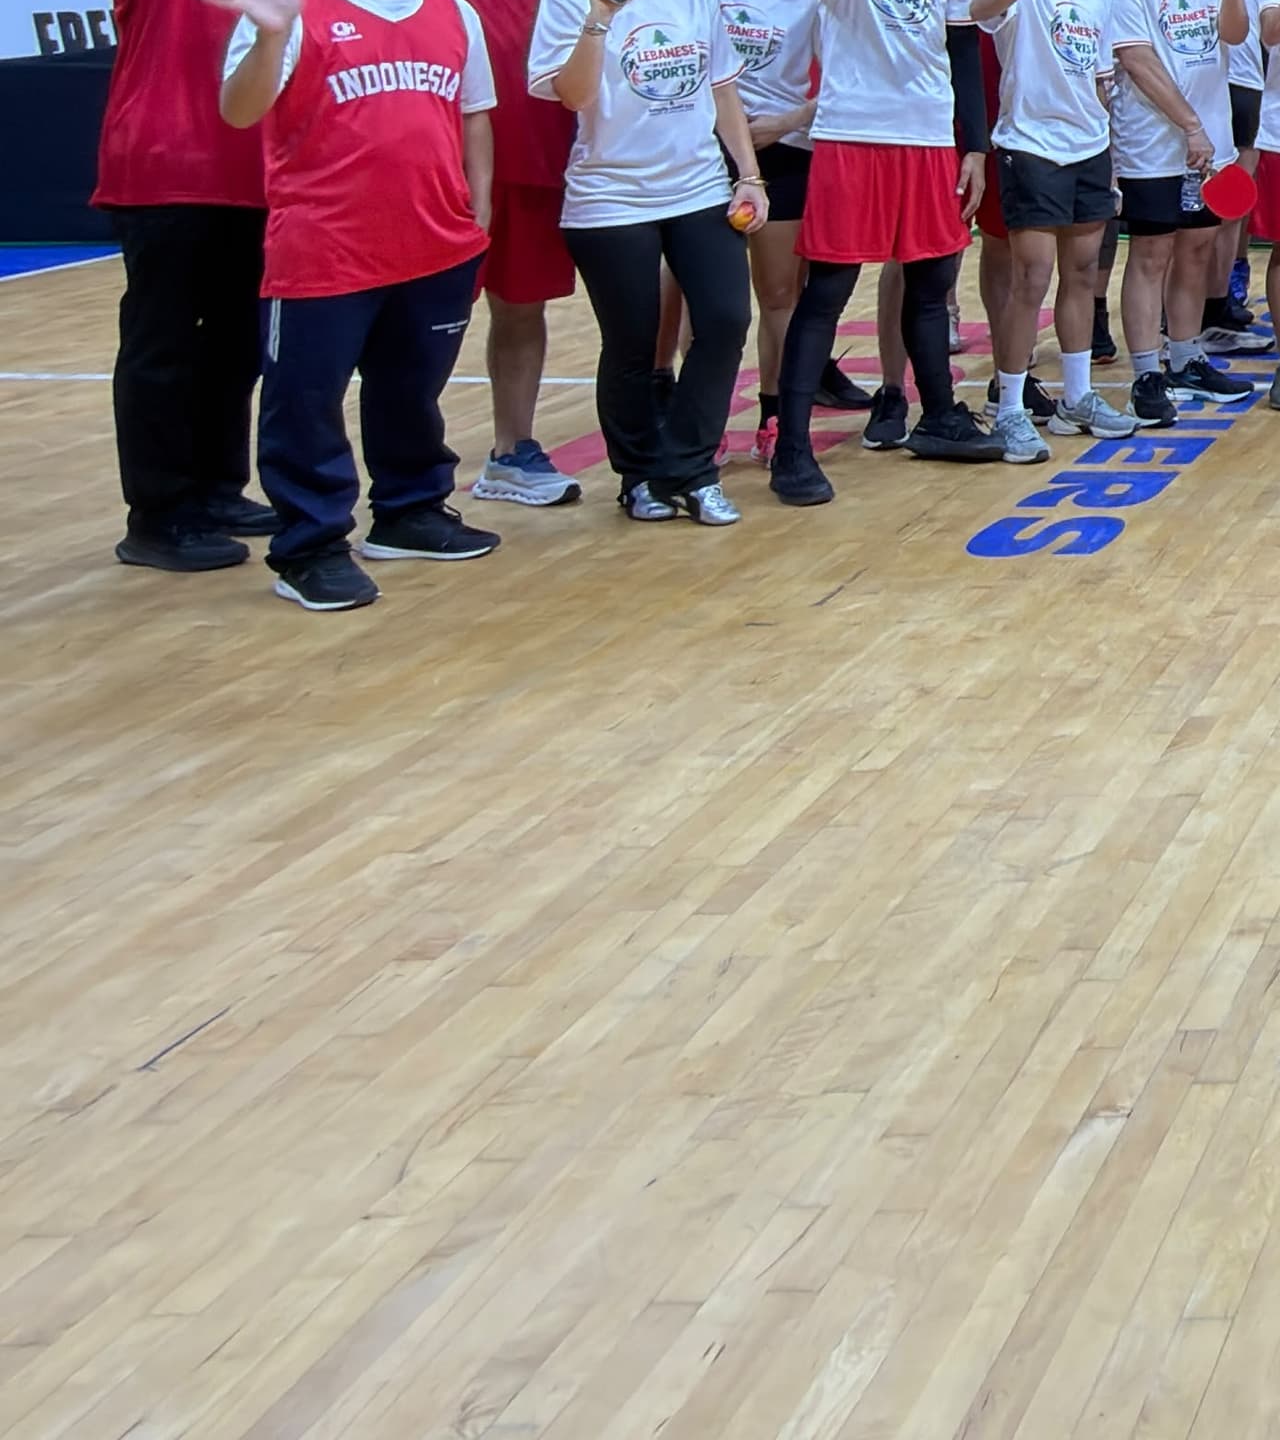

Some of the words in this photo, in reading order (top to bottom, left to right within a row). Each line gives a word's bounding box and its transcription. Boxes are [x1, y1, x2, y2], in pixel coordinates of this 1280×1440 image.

[726, 24, 769, 40] BANESE
[637, 44, 697, 62] LEBANESE
[643, 63, 697, 81] SPORTS
[327, 61, 461, 104] INDONESIA
